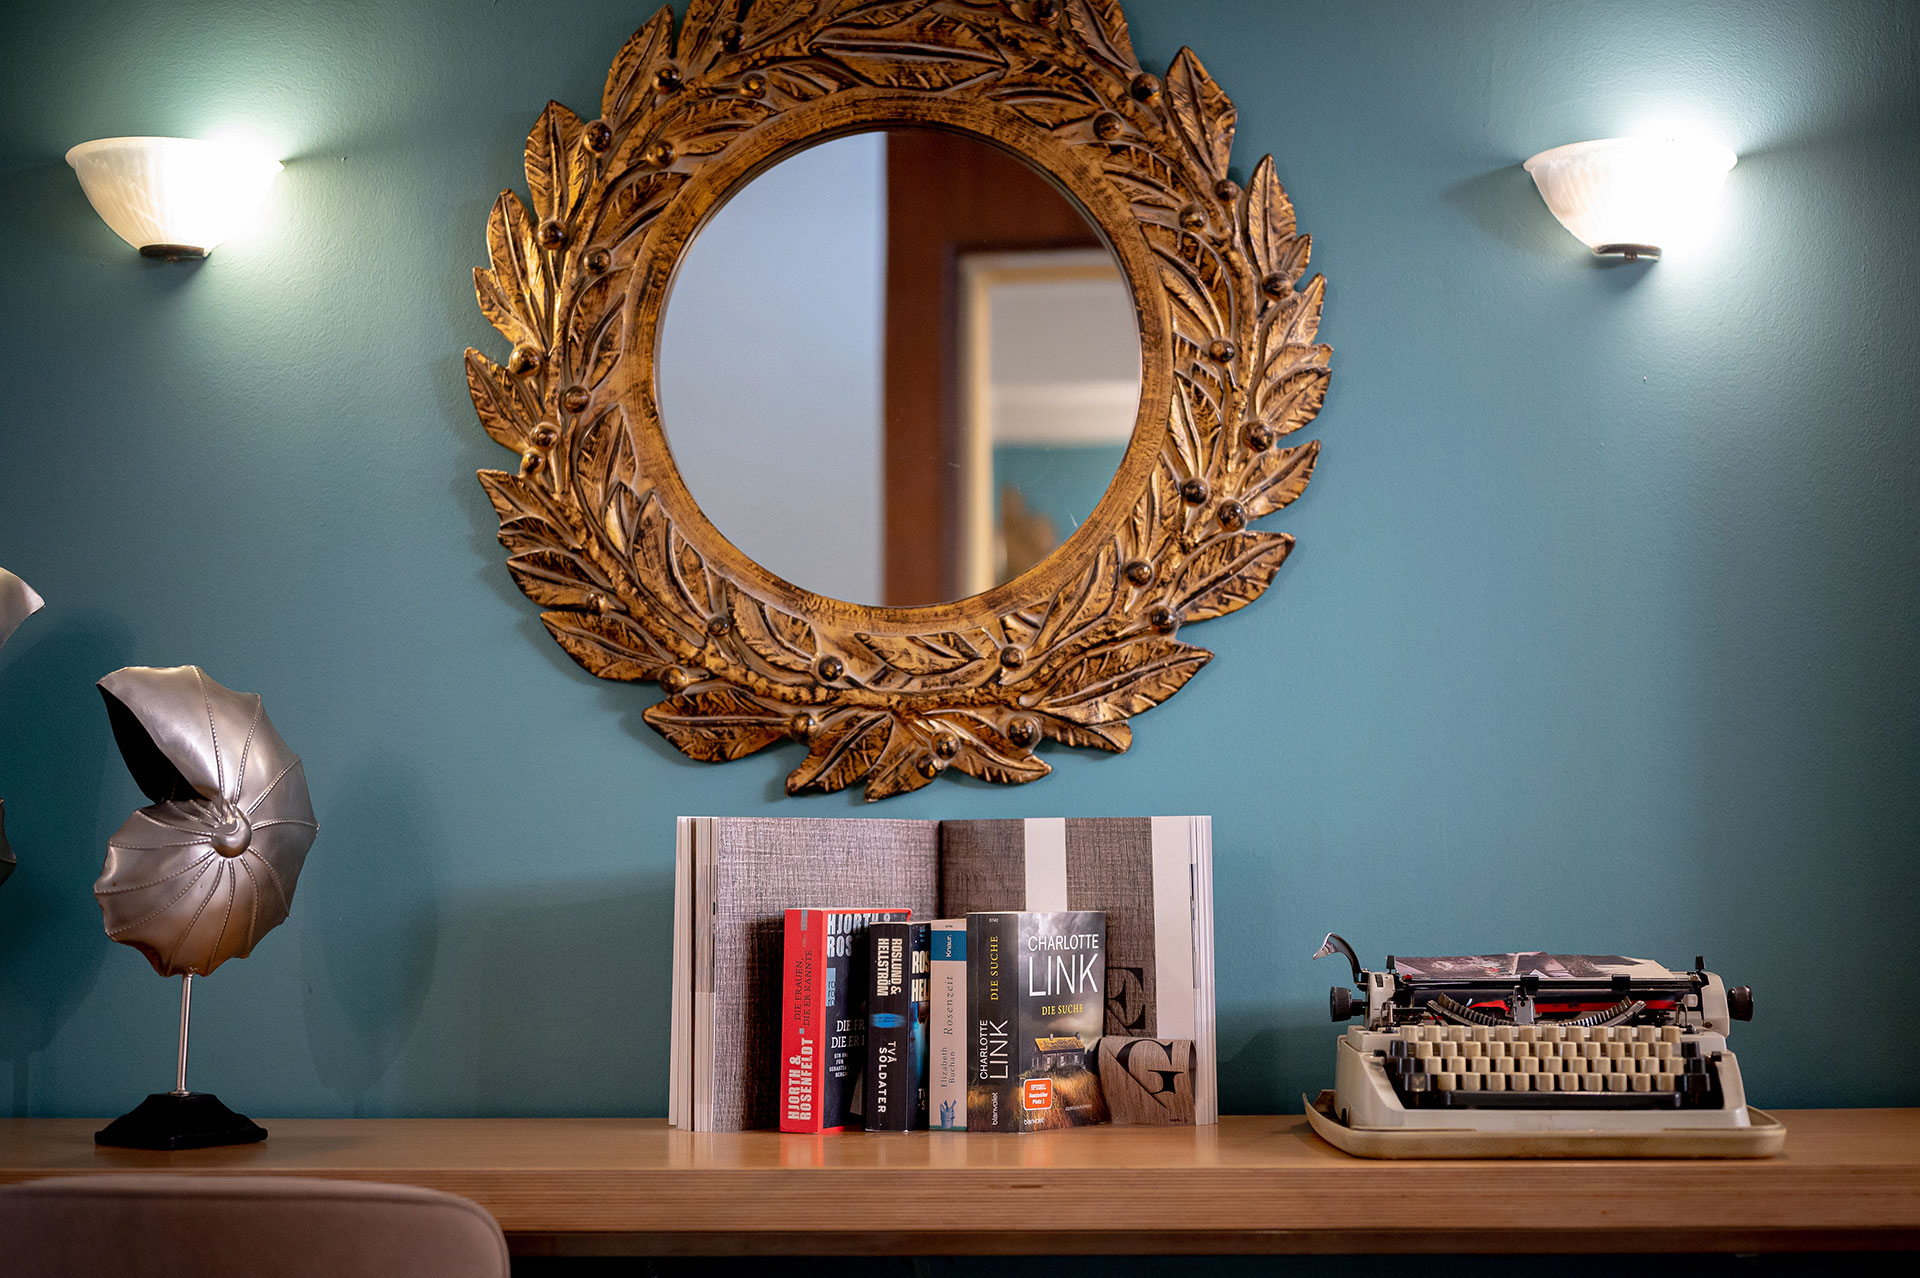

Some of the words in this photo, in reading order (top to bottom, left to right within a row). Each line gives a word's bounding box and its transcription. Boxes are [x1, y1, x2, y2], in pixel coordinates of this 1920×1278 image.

[891, 938, 902, 985] ROSLUND
[990, 936, 998, 976] SUCHE
[1028, 934, 1099, 952] CHARLOTTE
[794, 958, 804, 1000] FRAUEN,
[804, 950, 812, 990] KANNTE
[877, 938, 890, 996] HELLSTRÖM
[1029, 954, 1098, 996] LINK
[804, 994, 811, 1006] ER
[890, 986, 902, 996] &
[944, 976, 954, 1035] Rosenzeit
[990, 980, 998, 1000] DIE
[1042, 1005, 1056, 1016] DIE
[1058, 1004, 1084, 1014] SUCHE
[831, 1036, 846, 1048] DIE
[836, 1020, 851, 1032] DIE
[790, 1055, 801, 1066] &
[888, 1041, 898, 1063] TVÅ
[980, 1020, 988, 1080] CHARLOTTE
[990, 1020, 1008, 1078] LINK
[788, 1070, 800, 1120] HJORTH
[800, 1038, 813, 1120] ROSENFELDT
[878, 1048, 888, 1113] SOLDATER
